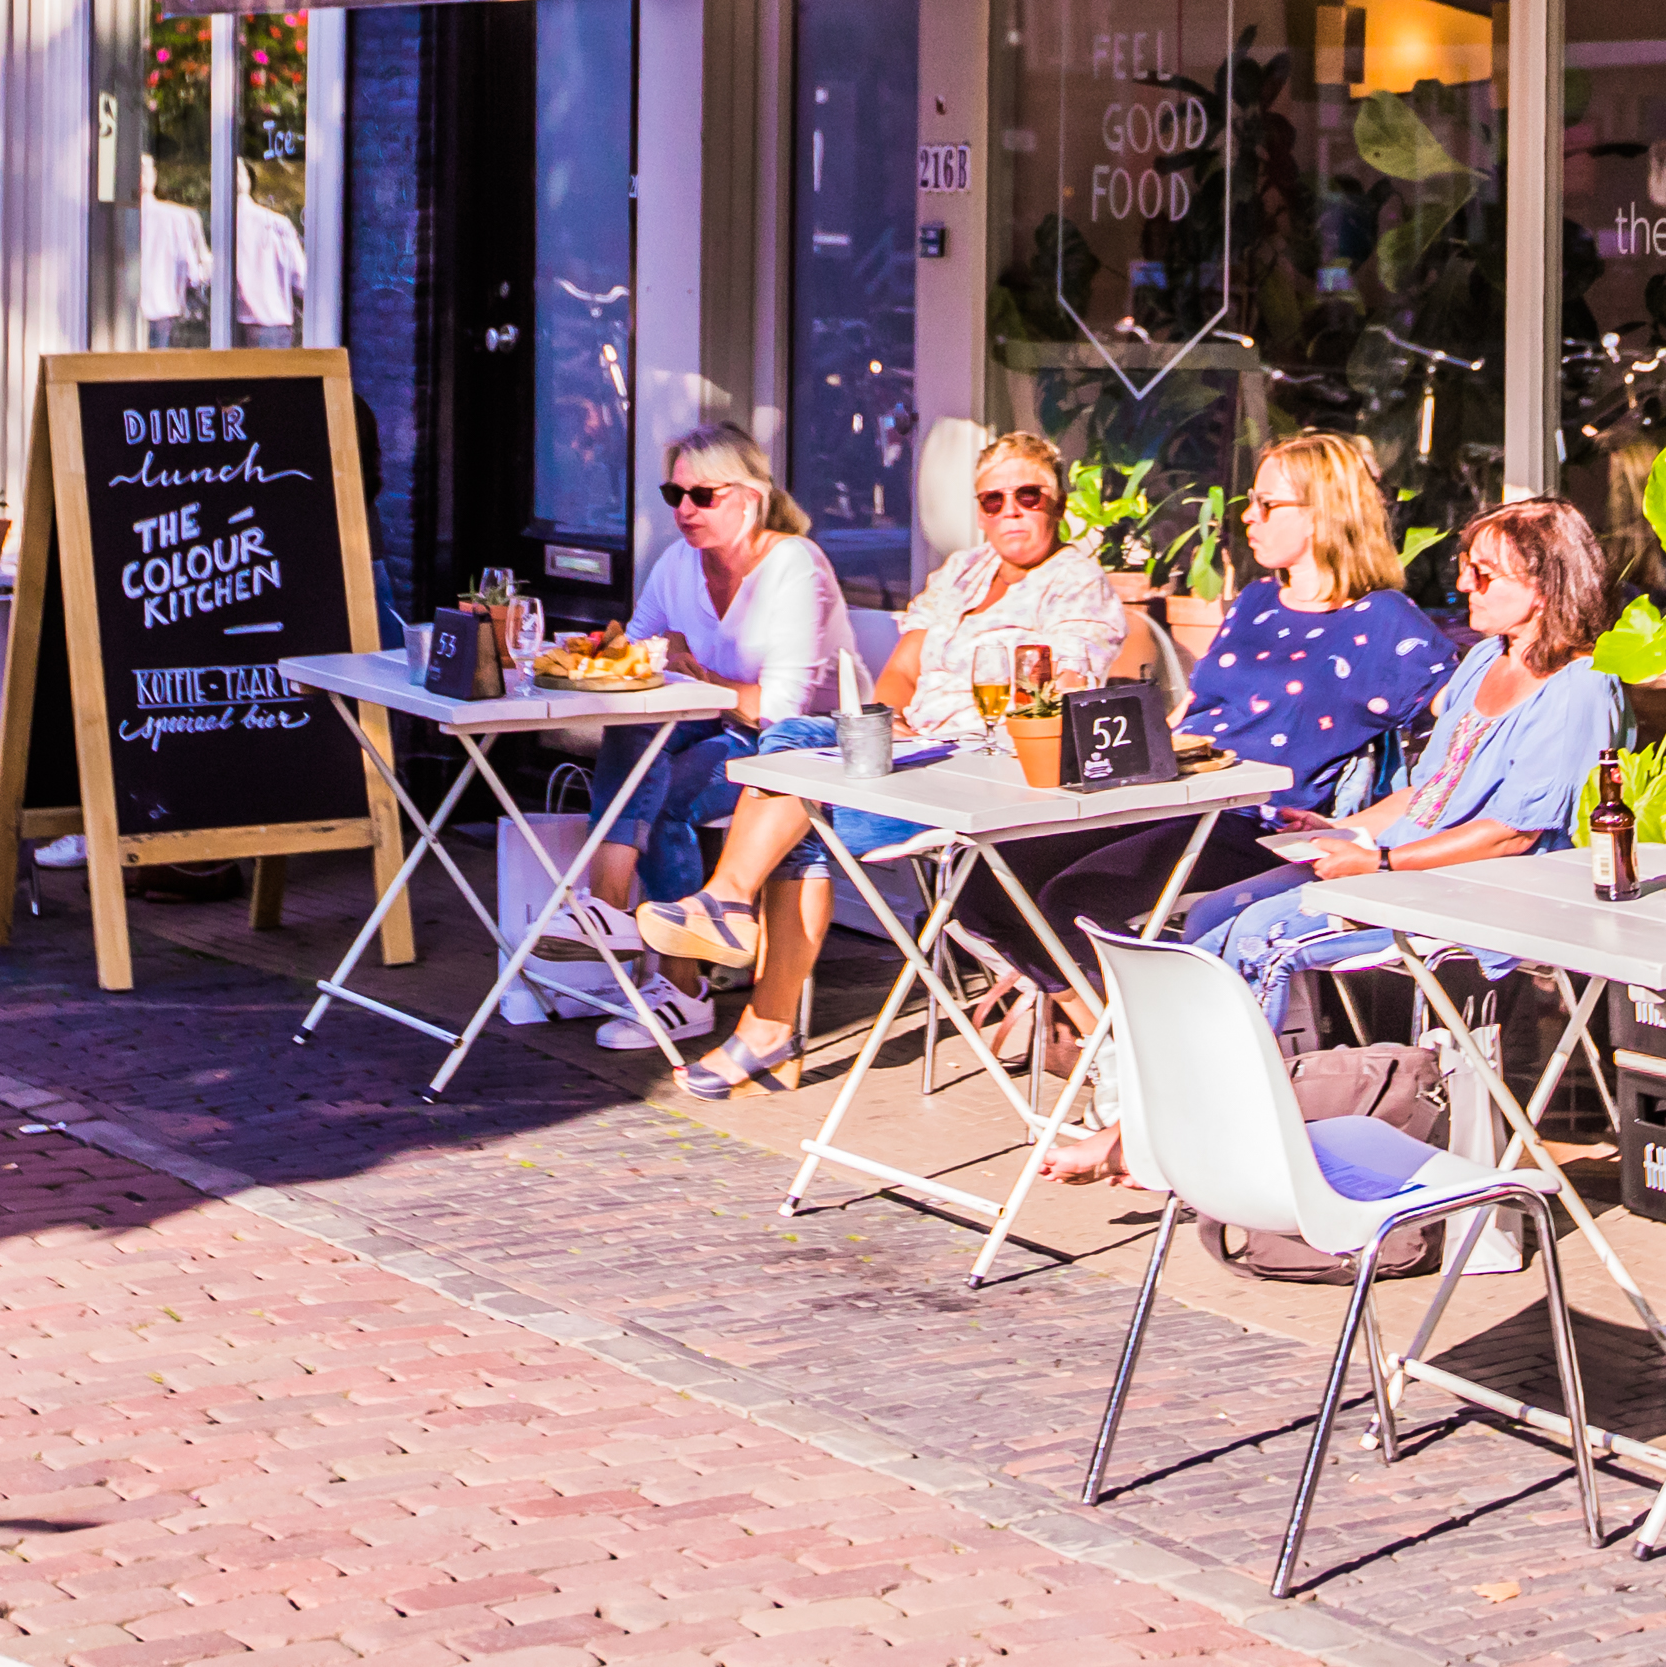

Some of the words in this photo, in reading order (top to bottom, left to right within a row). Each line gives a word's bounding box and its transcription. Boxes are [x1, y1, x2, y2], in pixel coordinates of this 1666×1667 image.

[1092, 30, 1173, 81] FEEL
[1102, 97, 1208, 157] GOOD
[920, 149, 967, 188] 216B
[1091, 165, 1191, 222] FOOD
[123, 404, 248, 445] DINER
[110, 442, 313, 487] lunch
[133, 501, 201, 554] THE
[122, 526, 274, 599] COLOUR
[144, 560, 282, 629] KITCHEN
[436, 632, 457, 658] 53
[241, 703, 310, 729] bier
[1093, 716, 1132, 749] 52
